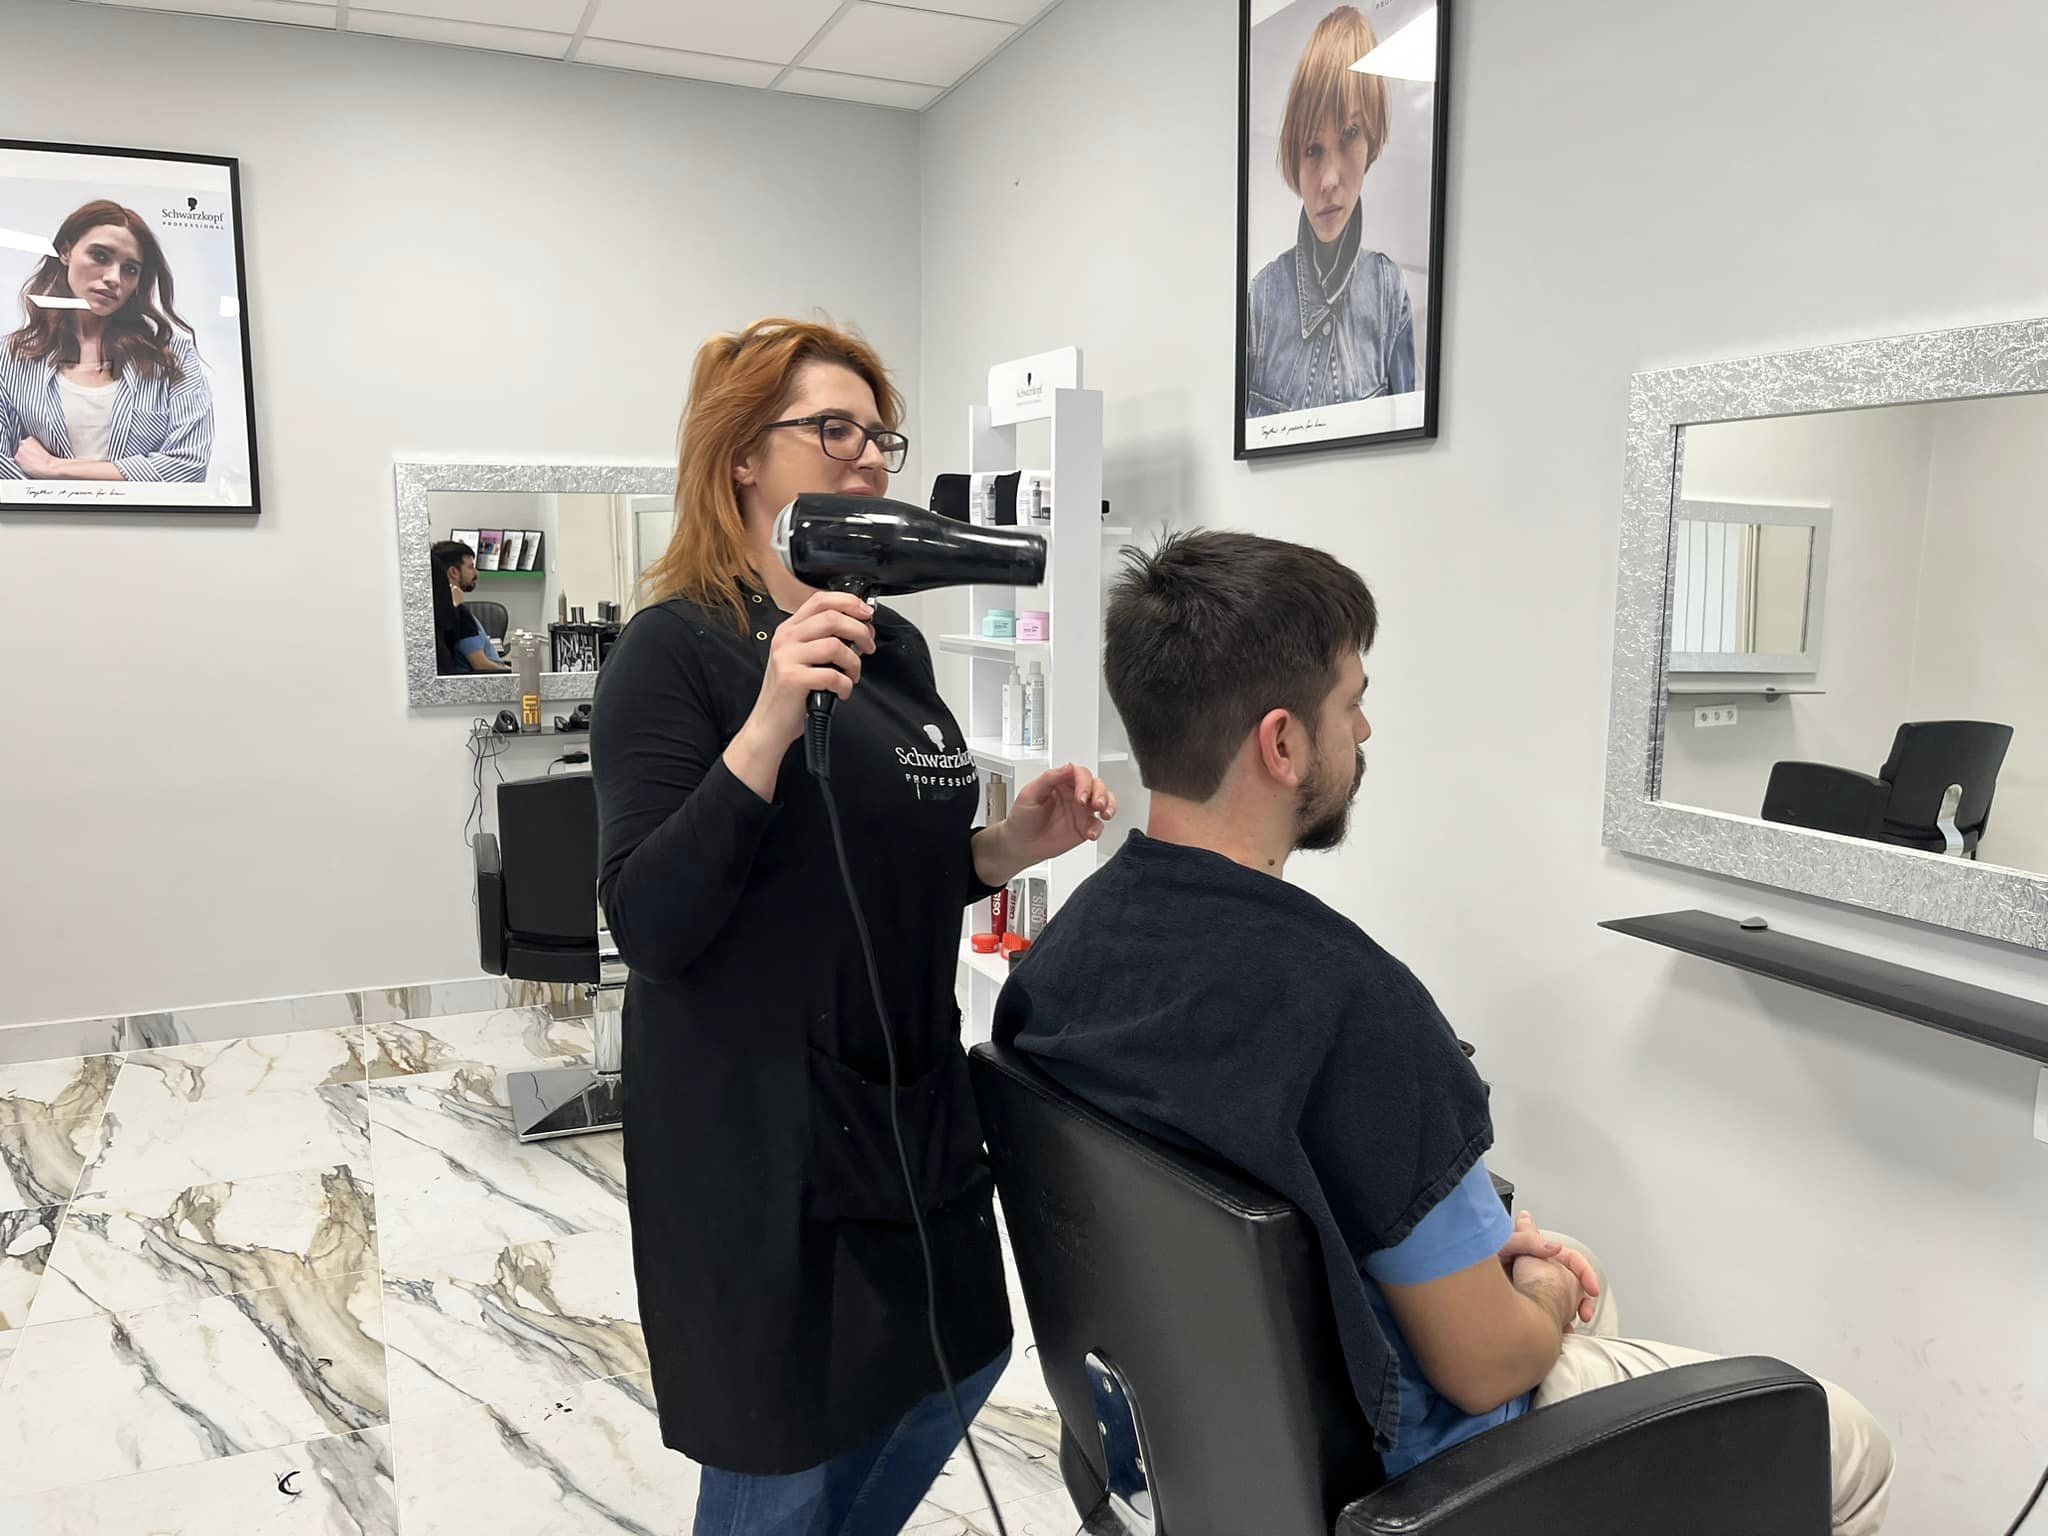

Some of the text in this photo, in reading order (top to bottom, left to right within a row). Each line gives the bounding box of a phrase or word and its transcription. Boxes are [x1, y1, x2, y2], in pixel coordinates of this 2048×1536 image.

[161, 208, 225, 225] Schwarzkopf
[895, 746, 976, 769] Schwarzko
[905, 772, 977, 787] PROFESSIO
